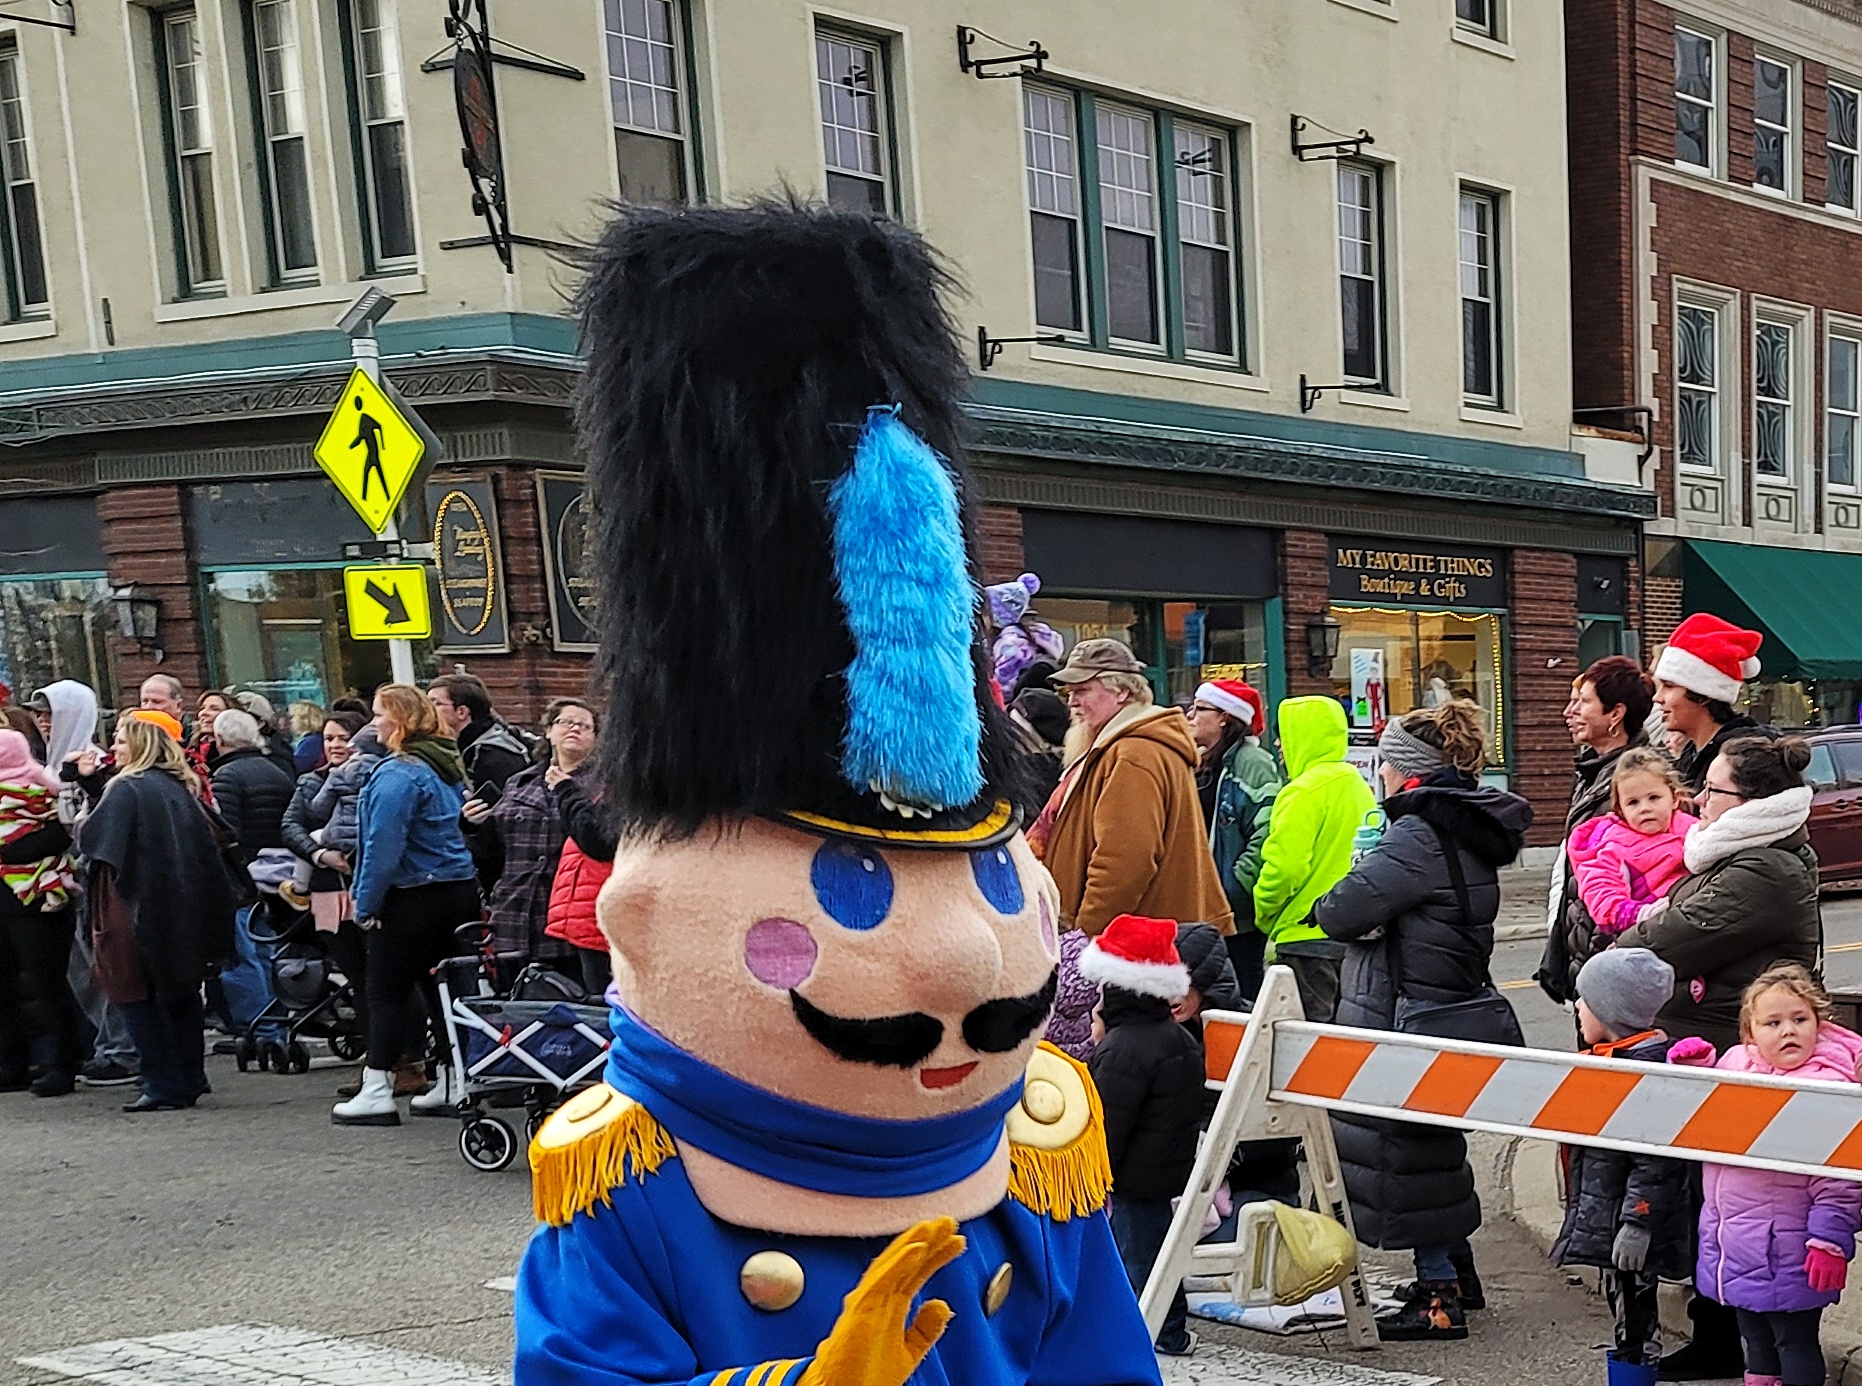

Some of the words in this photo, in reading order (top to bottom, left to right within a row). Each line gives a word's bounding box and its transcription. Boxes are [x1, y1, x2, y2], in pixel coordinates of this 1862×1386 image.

[1336, 549, 1363, 569] MY
[1365, 550, 1436, 574] FAVORITE
[1436, 556, 1494, 578] THINGS
[1359, 574, 1416, 601] Boutique
[1419, 578, 1432, 596] &
[1433, 577, 1467, 602] Gifts
